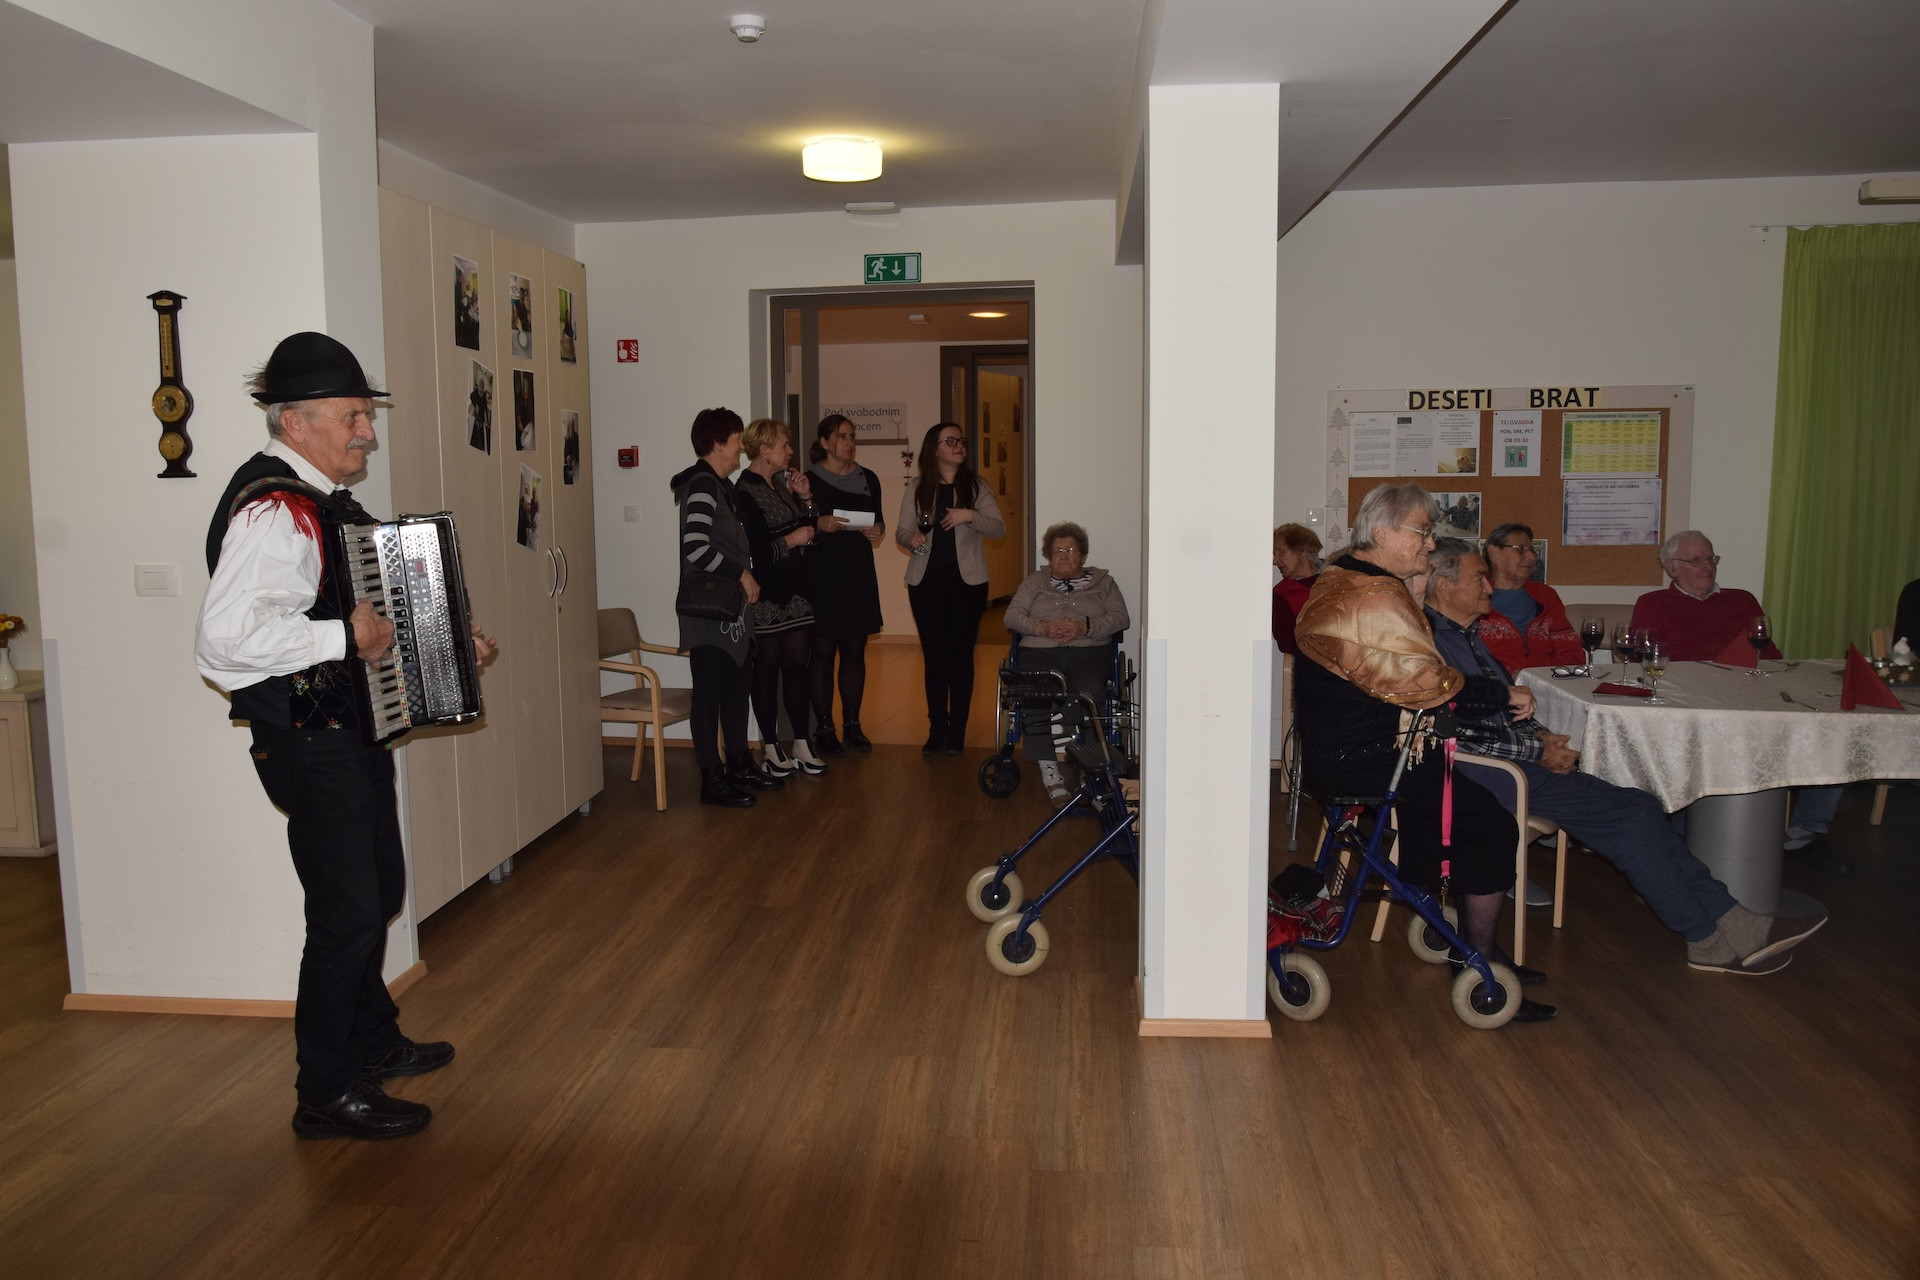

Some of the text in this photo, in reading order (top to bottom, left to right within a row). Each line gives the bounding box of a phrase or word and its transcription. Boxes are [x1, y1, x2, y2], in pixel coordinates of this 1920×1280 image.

[1409, 387, 1599, 410] DESETI BRAT
[824, 407, 899, 417] Pod svobodnim
[854, 423, 881, 431] ncem
